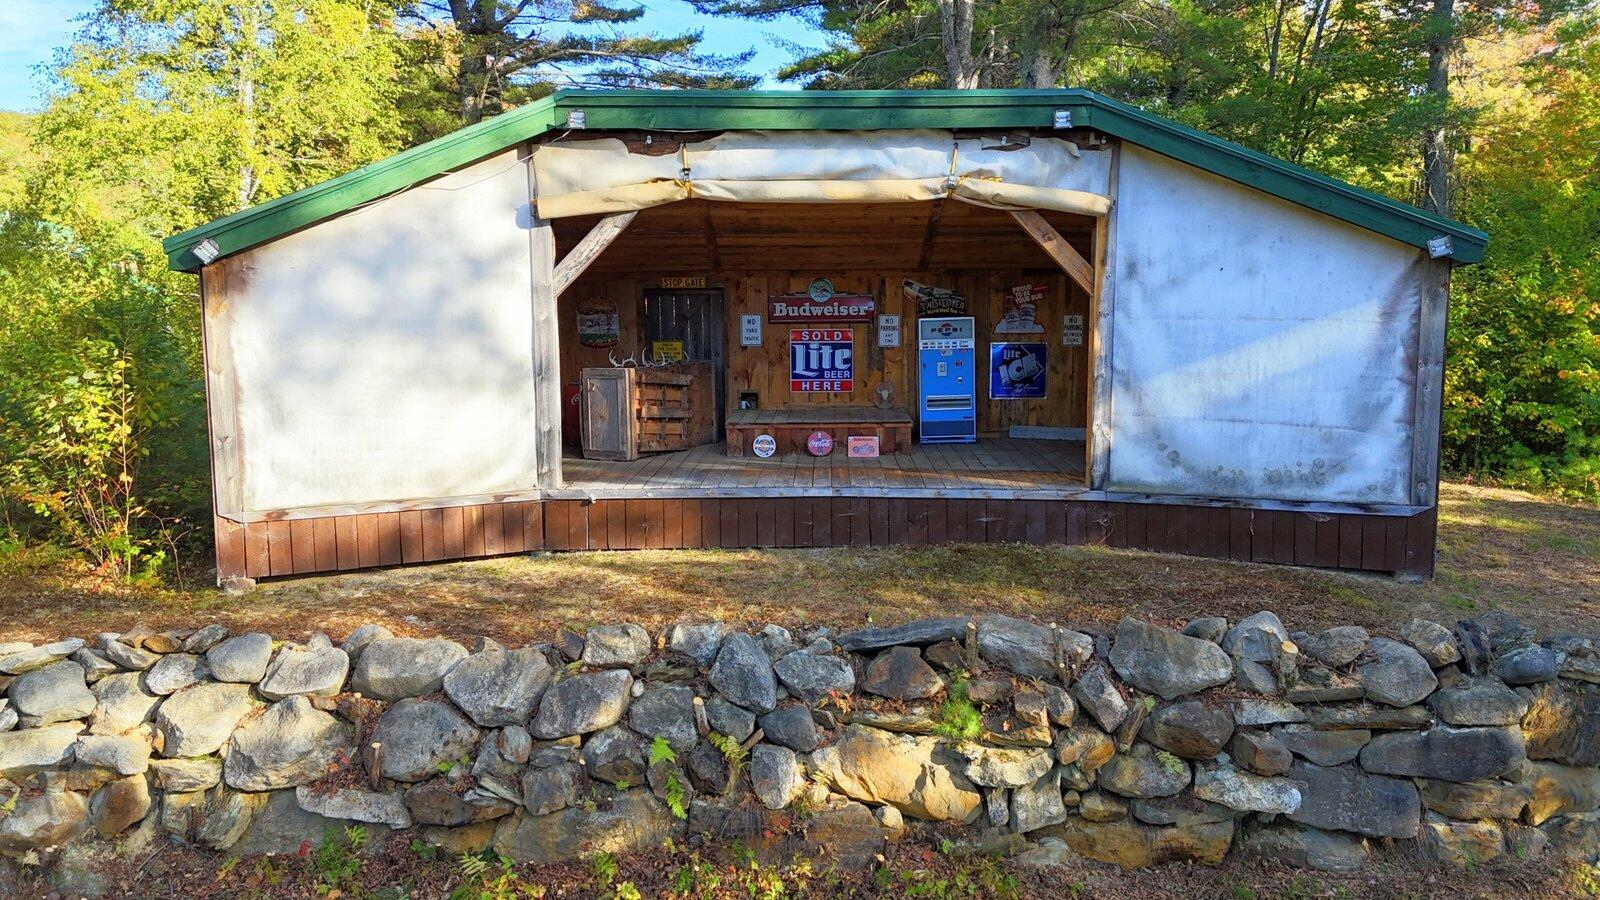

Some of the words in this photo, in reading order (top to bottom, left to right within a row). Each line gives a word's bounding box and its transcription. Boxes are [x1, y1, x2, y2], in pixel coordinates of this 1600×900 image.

[664, 278, 682, 287] STOP
[685, 278, 703, 287] GATE
[1012, 284, 1032, 293] PROUD
[773, 302, 869, 317] Budweiser
[802, 331, 842, 340] SOLD
[1003, 350, 1021, 360] Lite
[792, 343, 852, 378] Lite
[824, 370, 850, 378] BEER
[802, 381, 842, 390] HERE
